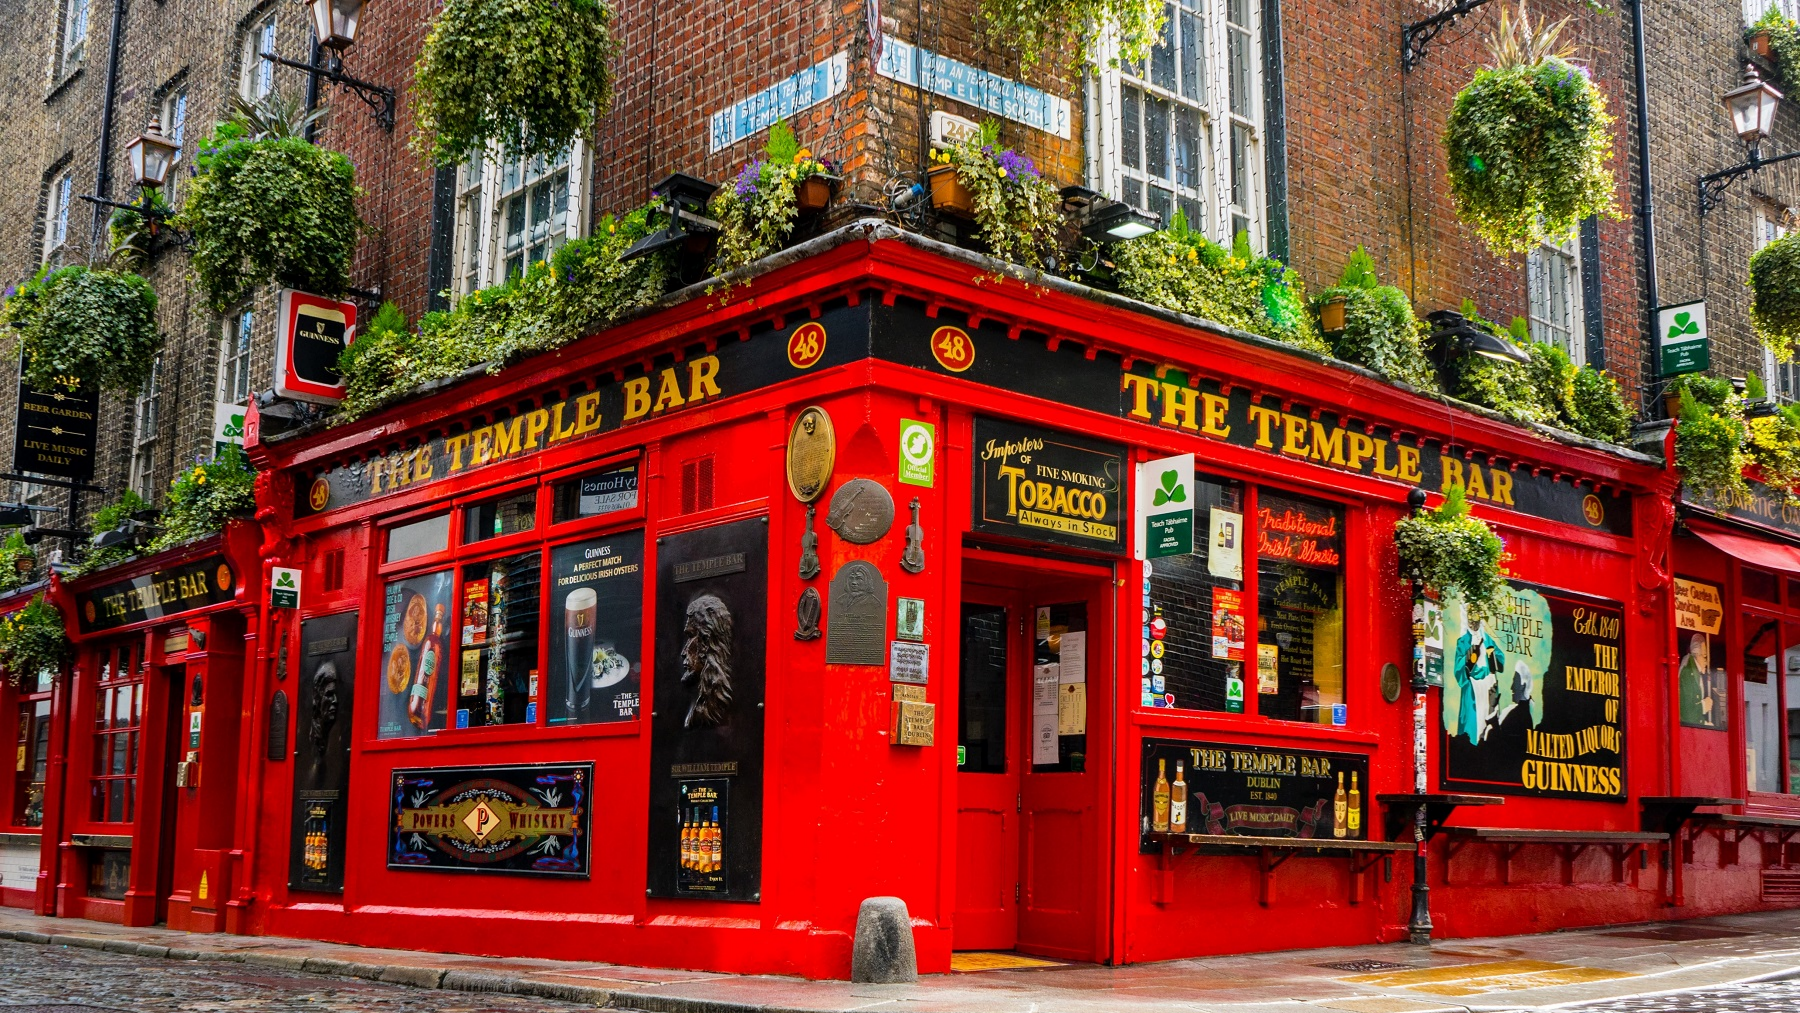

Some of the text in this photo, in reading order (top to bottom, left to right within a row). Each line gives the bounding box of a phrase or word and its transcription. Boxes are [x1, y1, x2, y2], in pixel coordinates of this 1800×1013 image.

[834, 65, 842, 83] 2
[949, 64, 963, 78] AN
[921, 72, 1043, 122] TEMPLE LANE SOUTH
[749, 102, 787, 129] TEMPLE
[299, 329, 339, 345] GUINNESS
[794, 330, 819, 361] 48
[939, 332, 966, 361] 48
[23, 402, 93, 420] BEER GARDEN
[367, 355, 721, 494] THE TEMPLE BAR
[23, 440, 88, 456] LIVE MUSIC
[980, 437, 1044, 464] Importers
[1121, 373, 1515, 506] THE TEMPLE BAR
[37, 453, 71, 465] DAILY
[907, 464, 927, 474] Official
[1020, 454, 1032, 464] OF
[905, 470, 929, 480] Member
[1037, 464, 1106, 489] FINE SMOKING
[312, 486, 328, 507] 48
[998, 464, 1107, 521] TOBACCO
[1585, 499, 1599, 519] 48
[1020, 510, 1114, 538] Always in Stock
[1258, 507, 1336, 537] Traditional
[585, 545, 611, 559] GUINNESS
[1257, 531, 1340, 566] Irish Music
[558, 563, 639, 587] FOR DELICIOUS IRISH OYSTERS
[573, 555, 622, 572] A PERFECT MATCH
[674, 553, 744, 575] THE TEMPLE BAR
[102, 571, 209, 618] THE TEMPLE BAR
[1273, 576, 1328, 605] TEMPLE BAR
[1674, 581, 1689, 597] Beer
[1690, 585, 1714, 603] Garden
[1502, 595, 1532, 618] THE
[568, 626, 593, 638] GUINNESS
[1493, 612, 1544, 640] TEMPLE
[1599, 615, 1619, 640] 1840
[1680, 613, 1696, 628] Area
[1505, 634, 1533, 658] BAR
[1593, 643, 1618, 671] THE
[1565, 665, 1620, 698] EMPEROR
[612, 698, 640, 709] TEMPLE
[620, 692, 632, 700] THE
[619, 707, 633, 717] BAR
[1604, 698, 1618, 724] OF
[1526, 724, 1622, 759] MALTED LIQUORS
[1190, 748, 1332, 779] THE TEMPLE BAR
[1247, 776, 1281, 789] DUBLIN
[1521, 759, 1621, 796] GUINNESS
[1250, 791, 1277, 801] EST. 1840
[412, 807, 566, 835] POWERS P WHISKEY
[1229, 811, 1296, 823] LIVE MUSIC DAILY
